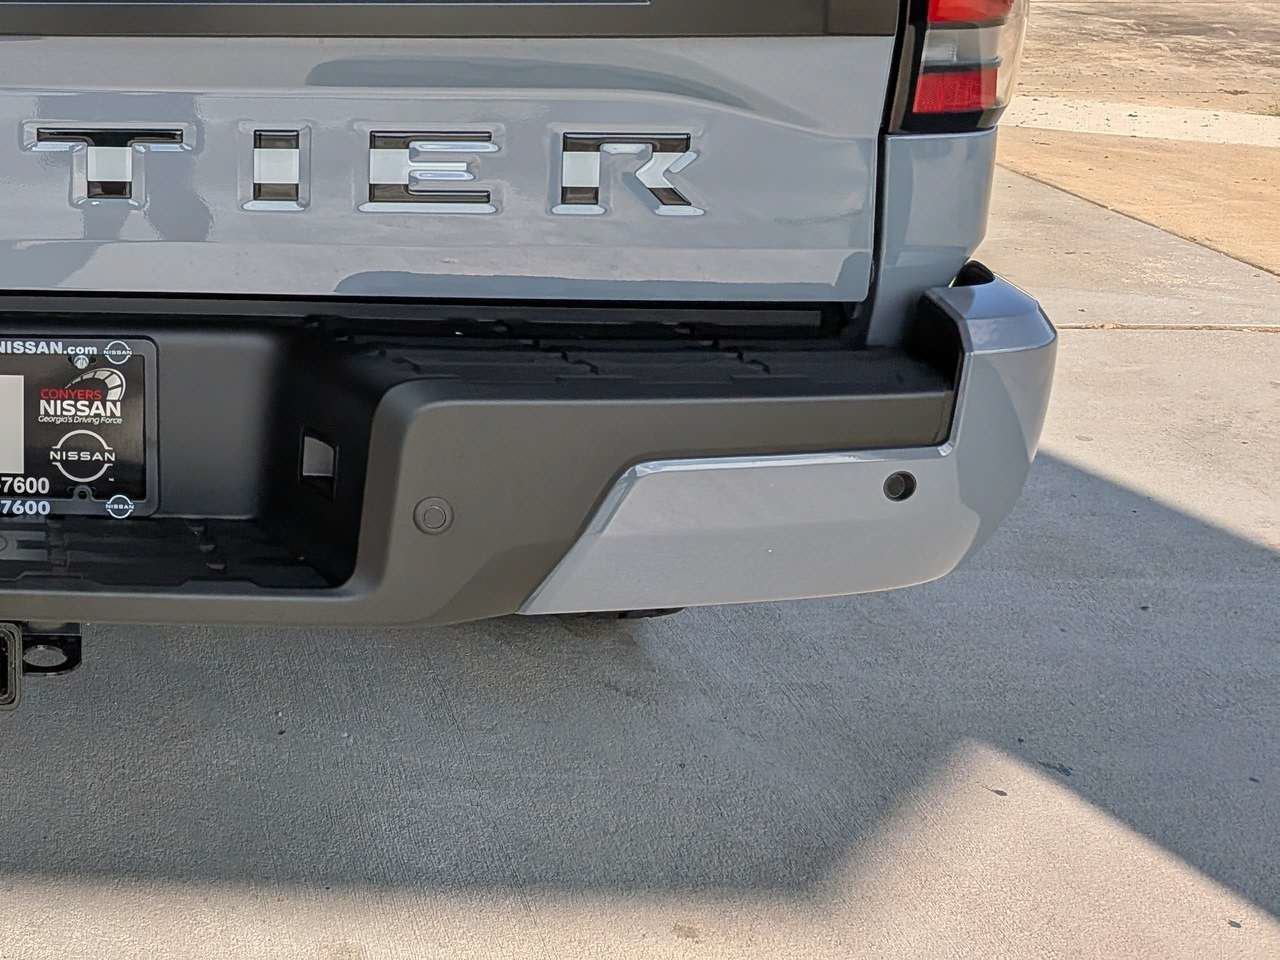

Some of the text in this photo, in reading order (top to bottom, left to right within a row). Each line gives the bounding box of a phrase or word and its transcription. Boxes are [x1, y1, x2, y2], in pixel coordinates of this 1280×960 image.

[40, 388, 103, 400] CONYERS
[39, 399, 122, 417] NISSAN
[73, 416, 100, 425] Driving
[100, 416, 122, 424] Force
[49, 451, 116, 461] NISSAN
